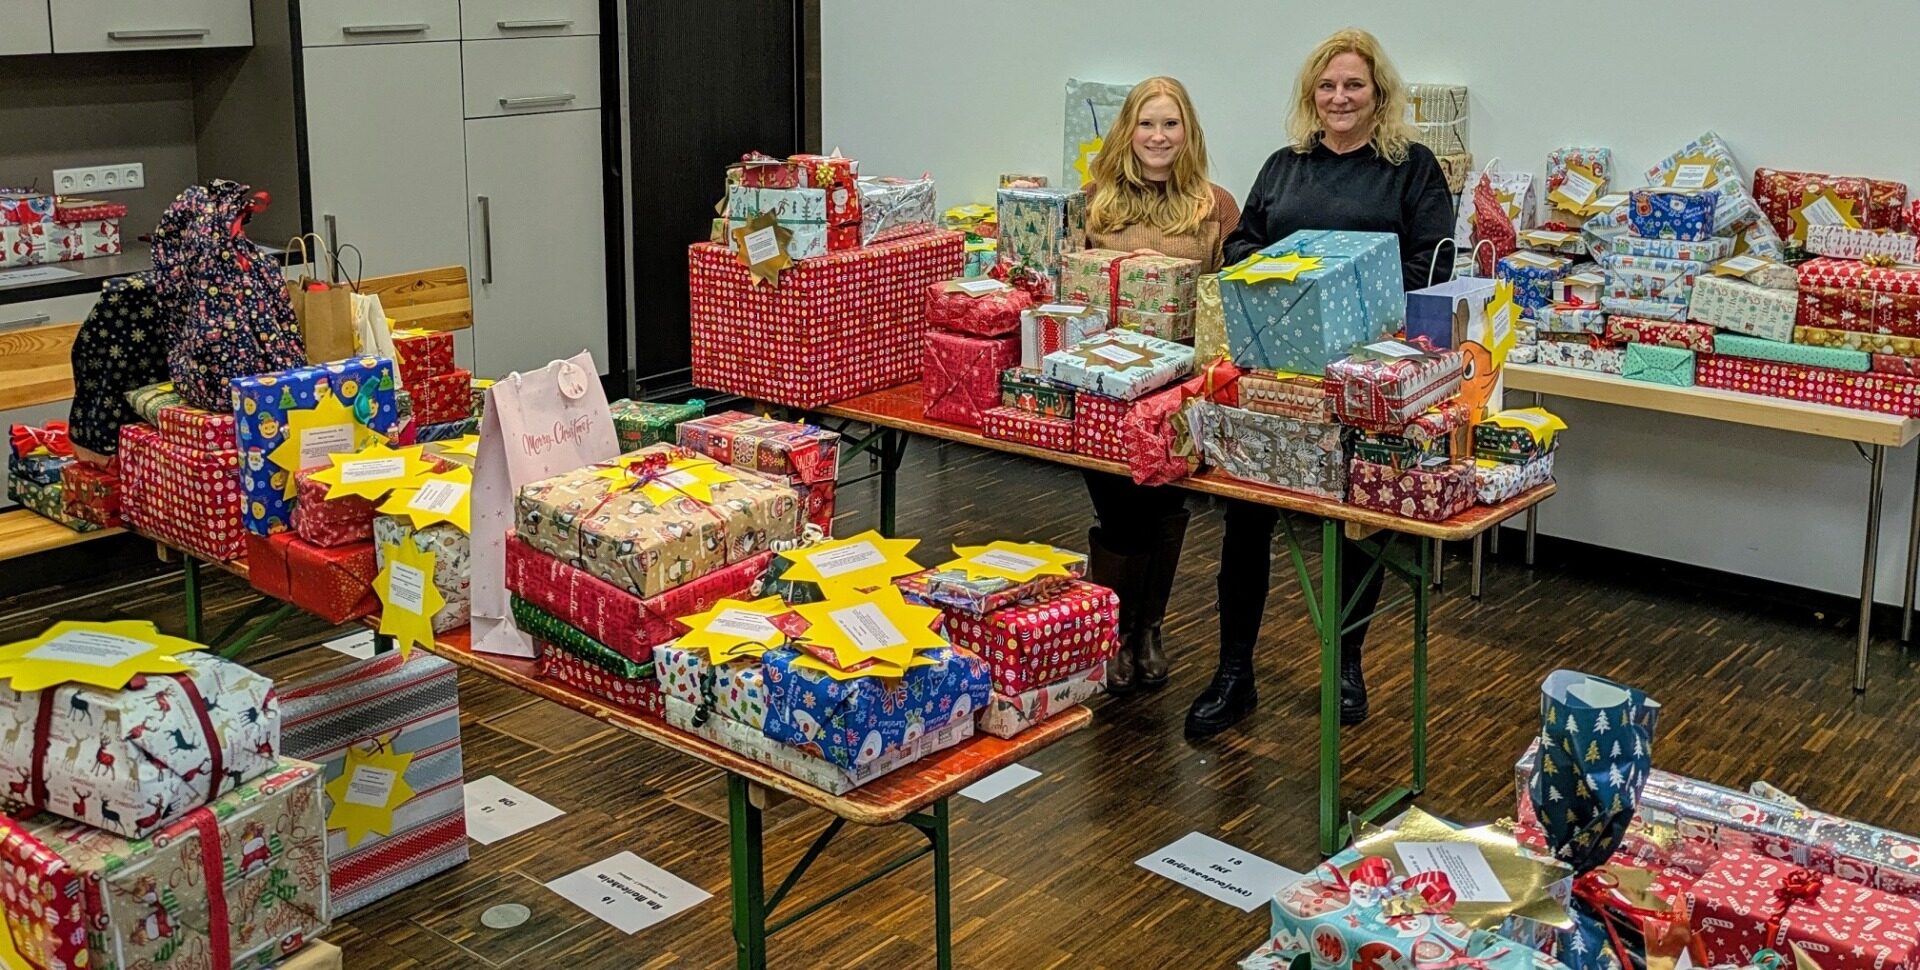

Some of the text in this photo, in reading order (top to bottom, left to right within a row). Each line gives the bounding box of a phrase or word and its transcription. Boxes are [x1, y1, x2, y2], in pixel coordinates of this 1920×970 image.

[522, 433, 554, 456] Merry
[553, 414, 594, 448] Christmas
[1227, 857, 1243, 866] 18
[1161, 857, 1253, 897] (Brückenprojekt)
[597, 873, 648, 902] Marienheim
[601, 896, 616, 905] 16
[646, 900, 663, 910] Am
